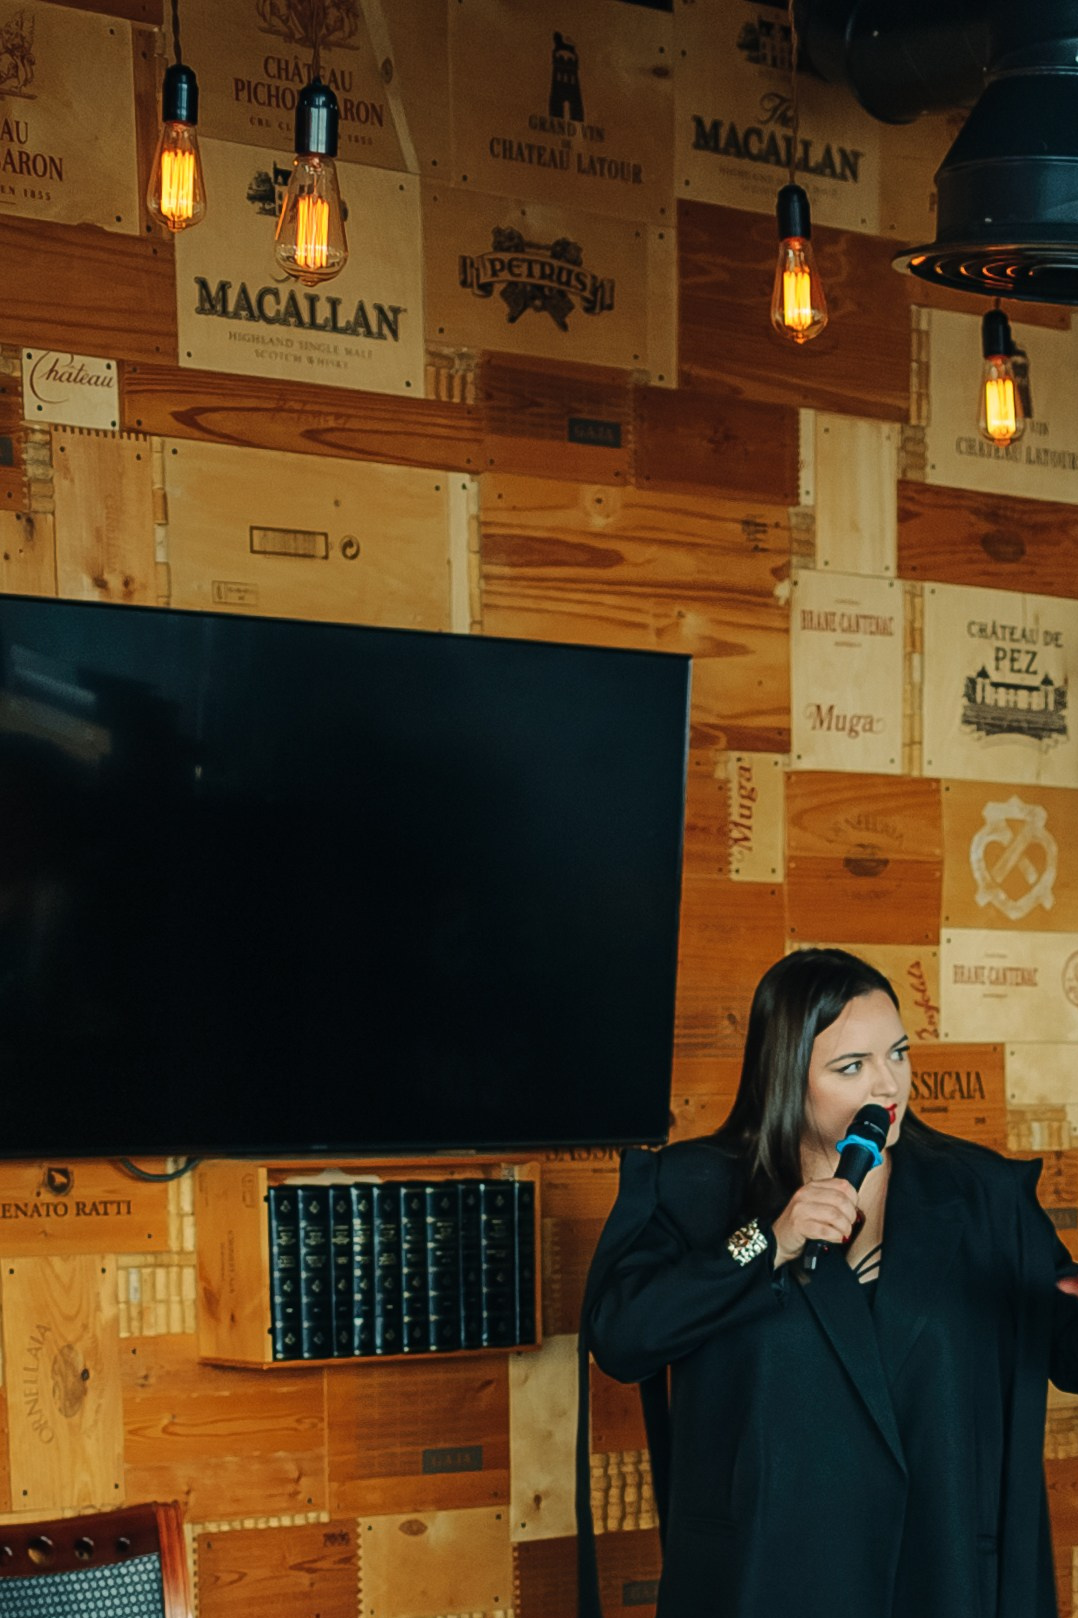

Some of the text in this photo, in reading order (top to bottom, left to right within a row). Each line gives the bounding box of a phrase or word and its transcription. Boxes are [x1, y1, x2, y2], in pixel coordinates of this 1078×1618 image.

[264, 55, 353, 92] CHÂTAU
[489, 137, 643, 184] CHATEAU LATOUR
[691, 114, 865, 183] MACALLAN
[488, 257, 588, 292] PETRUS
[194, 276, 404, 342] MACALLAN
[1042, 630, 1064, 648] DE
[994, 646, 1038, 675] PEZ
[804, 703, 886, 740] Muga
[729, 764, 758, 853] Muga
[75, 1199, 132, 1217] RATTI
[23, 1323, 55, 1445] ORNELLAIA
